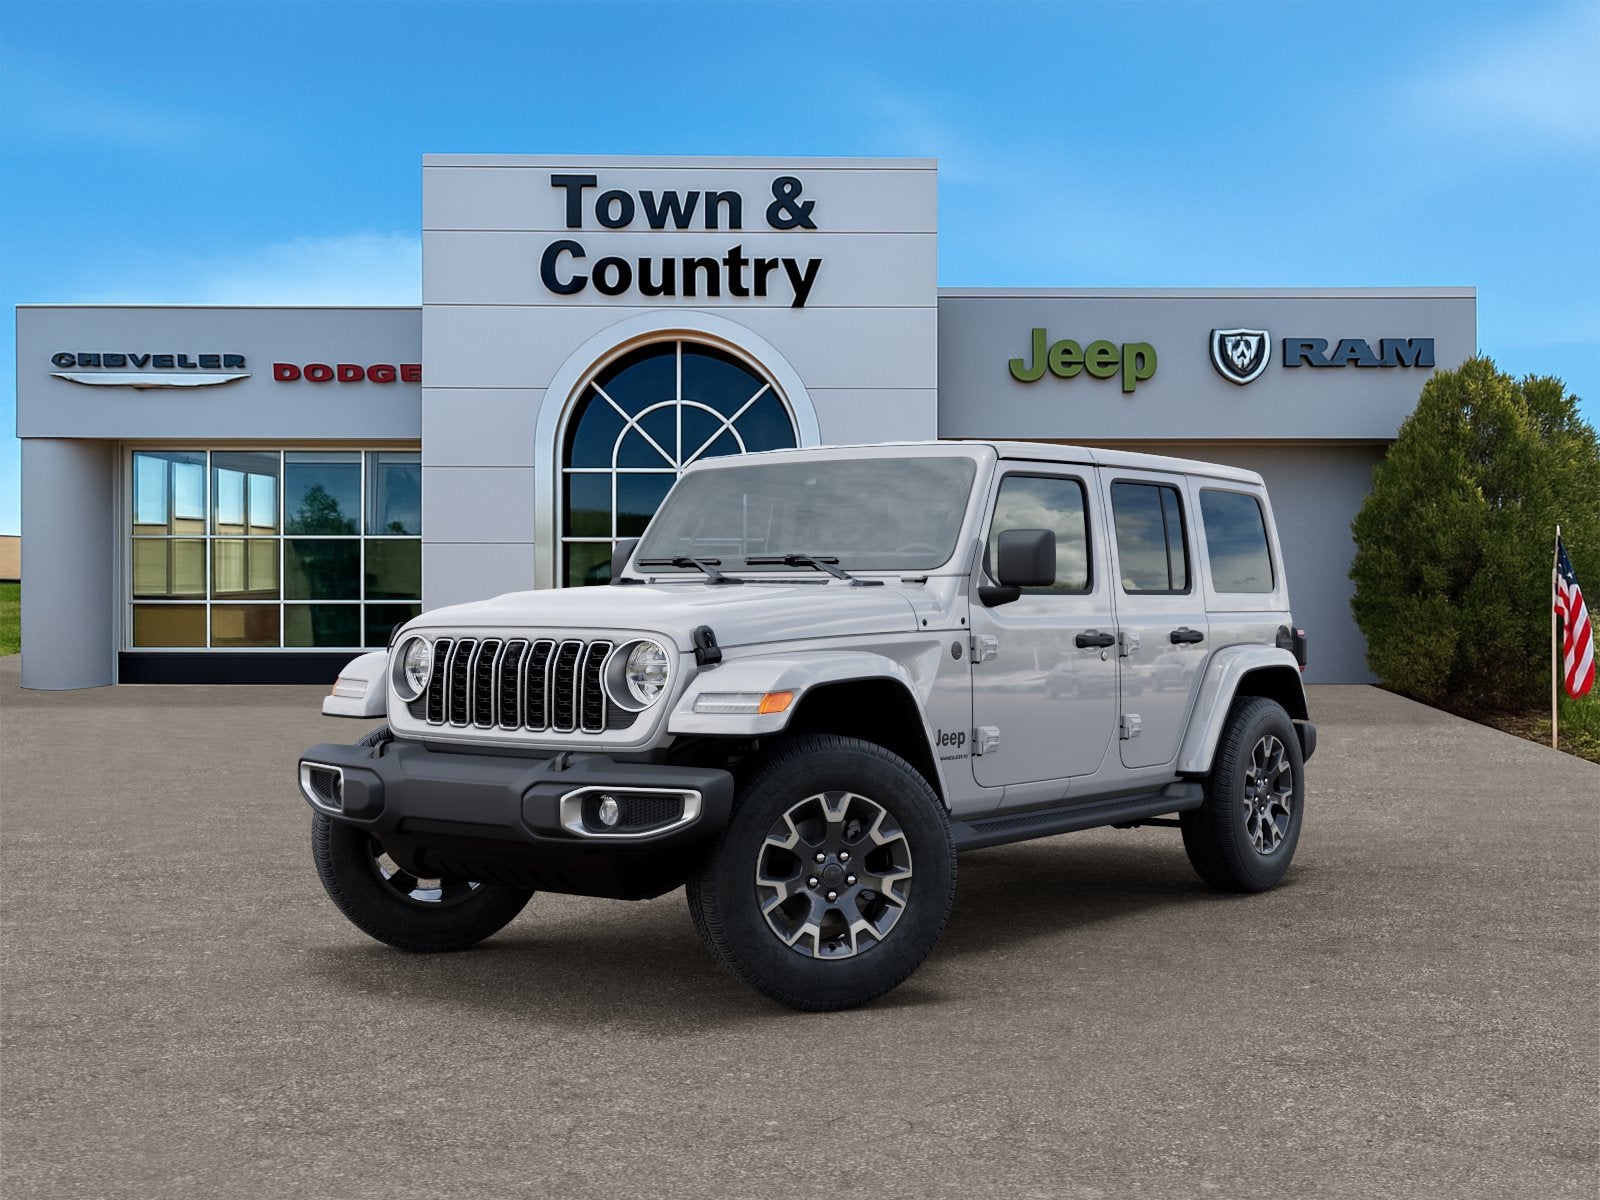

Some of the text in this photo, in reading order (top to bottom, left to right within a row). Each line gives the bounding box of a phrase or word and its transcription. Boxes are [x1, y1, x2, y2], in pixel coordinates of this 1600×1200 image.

[550, 174, 818, 230] Town &
[540, 239, 822, 308] Country
[273, 363, 422, 383] DODGE
[1009, 328, 1157, 393] Jeep
[1283, 338, 1435, 367] RAM
[936, 729, 965, 748] Jeep
